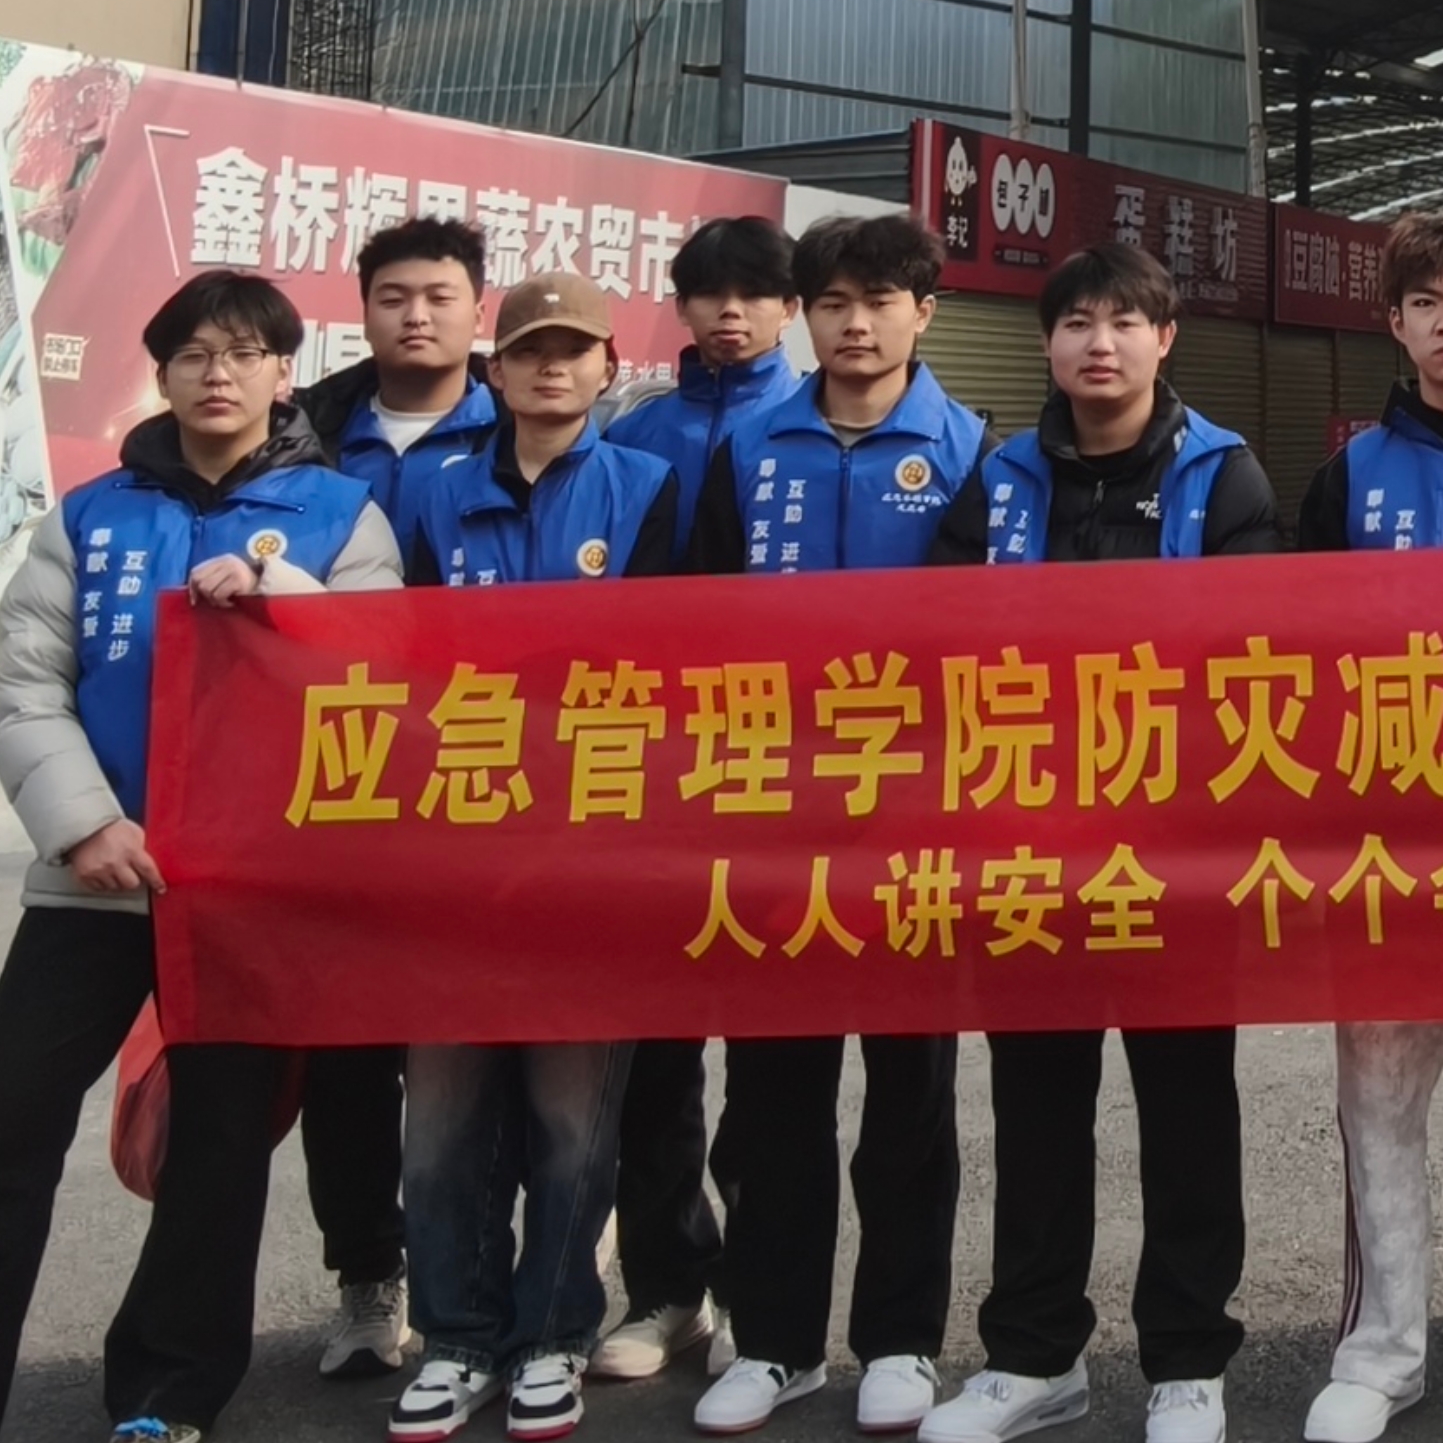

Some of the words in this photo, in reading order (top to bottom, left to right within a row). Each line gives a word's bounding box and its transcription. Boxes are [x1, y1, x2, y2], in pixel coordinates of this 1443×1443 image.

[117, 550, 147, 596] 互助
[684, 843, 1166, 959] 人人讲安全
